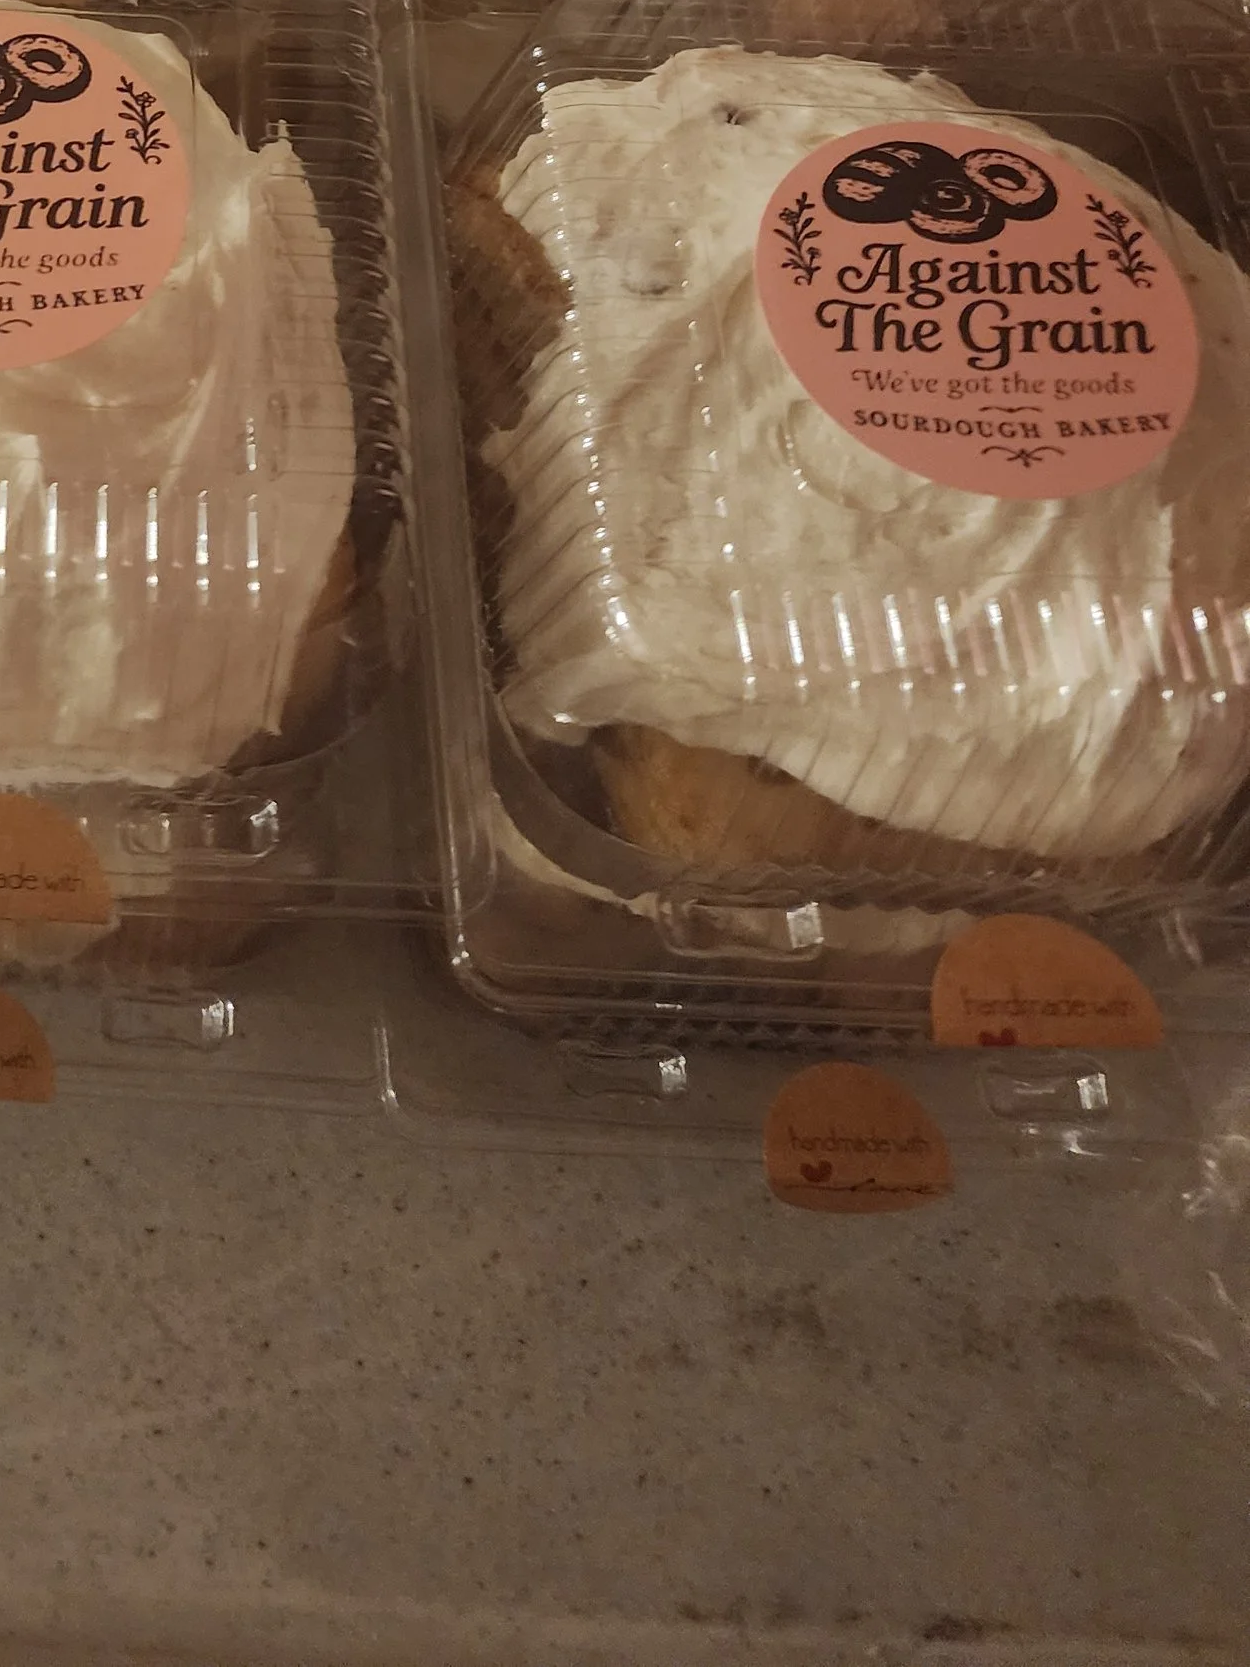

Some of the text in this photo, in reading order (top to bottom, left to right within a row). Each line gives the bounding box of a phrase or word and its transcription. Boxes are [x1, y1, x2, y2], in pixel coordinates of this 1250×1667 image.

[39, 246, 120, 274] goods
[836, 243, 1100, 309] Against
[32, 284, 146, 311] BAKERY
[815, 299, 1156, 371] The Grain
[852, 369, 1136, 400] We've got the goods
[853, 410, 1172, 438] SOURDOUGH BAKERY
[961, 982, 1087, 1018] handmade
[788, 1125, 891, 1155] handmade
